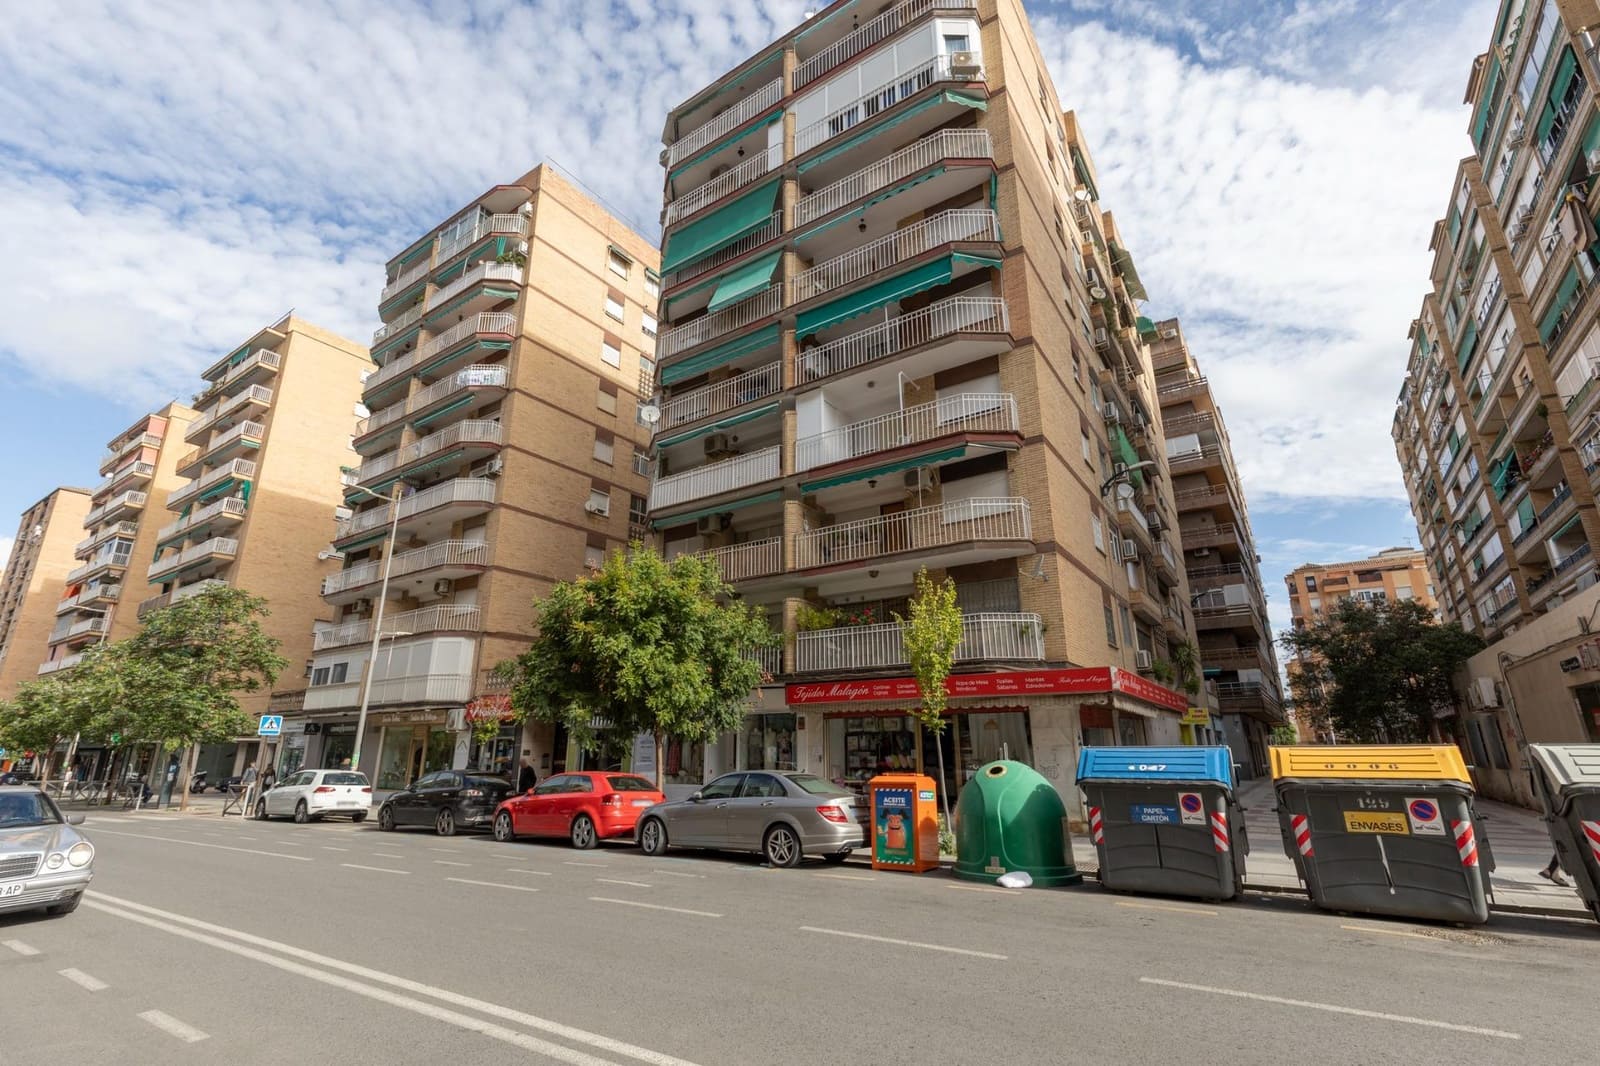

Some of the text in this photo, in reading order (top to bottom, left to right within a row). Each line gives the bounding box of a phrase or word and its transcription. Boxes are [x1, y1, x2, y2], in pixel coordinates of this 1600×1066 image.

[794, 684, 869, 702] Tejidos Malagón
[1350, 821, 1404, 832] ENVASES
